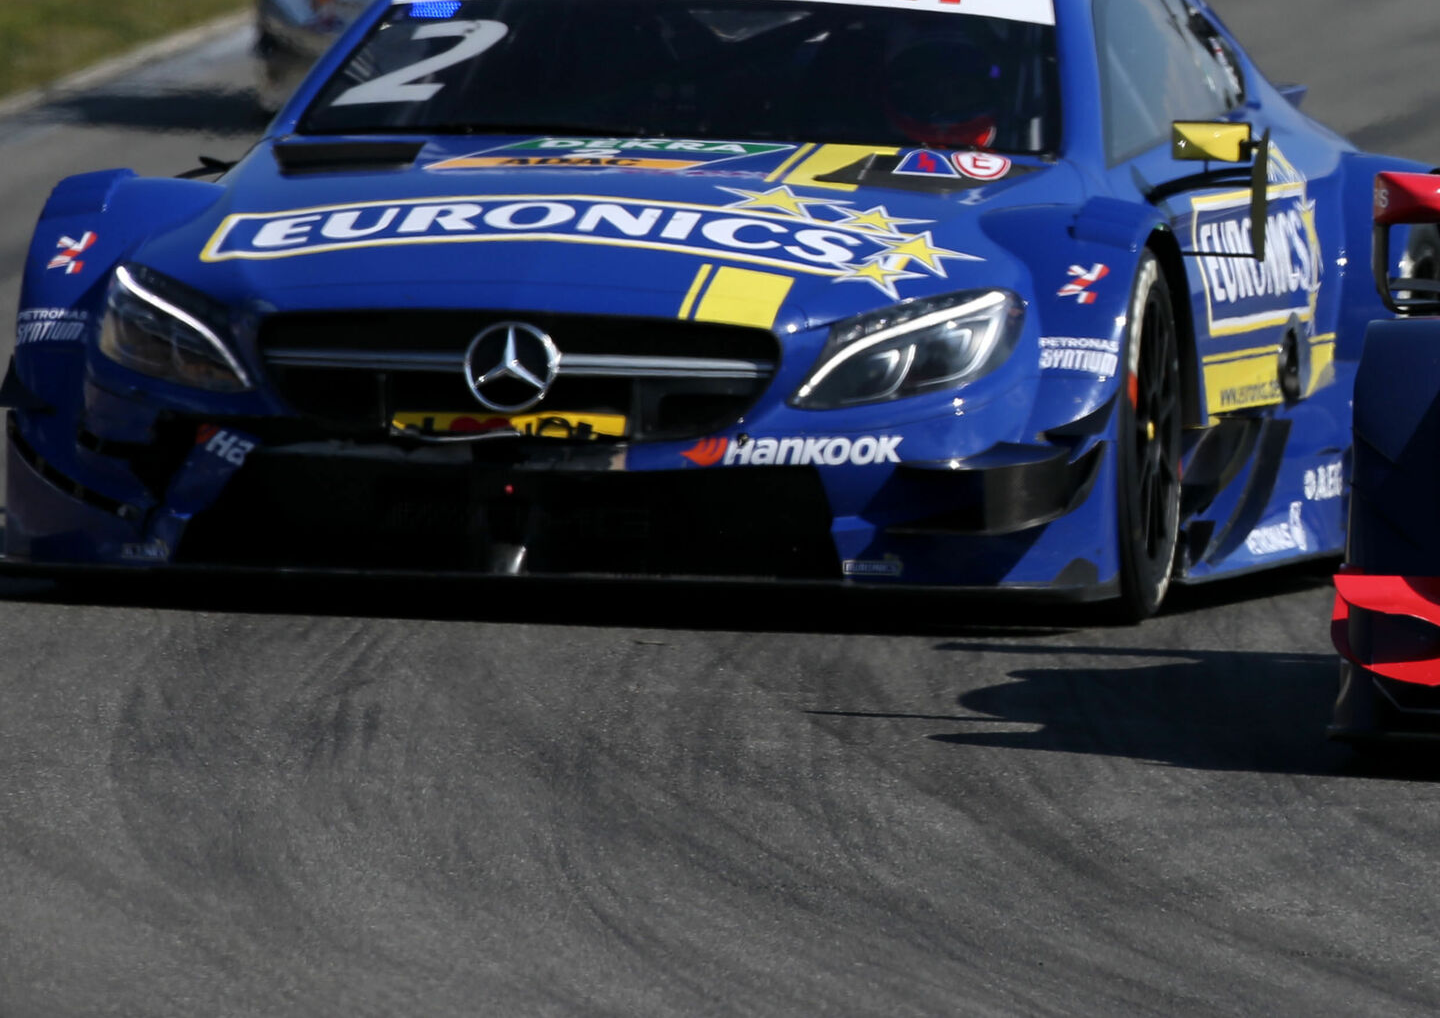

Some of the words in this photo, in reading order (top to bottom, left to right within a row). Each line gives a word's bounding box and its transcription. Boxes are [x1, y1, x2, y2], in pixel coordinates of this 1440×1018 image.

[330, 19, 510, 107] 2
[538, 137, 749, 155] DEKRA
[250, 200, 864, 264] EURONICS
[1039, 336, 1120, 353] PETRONAS
